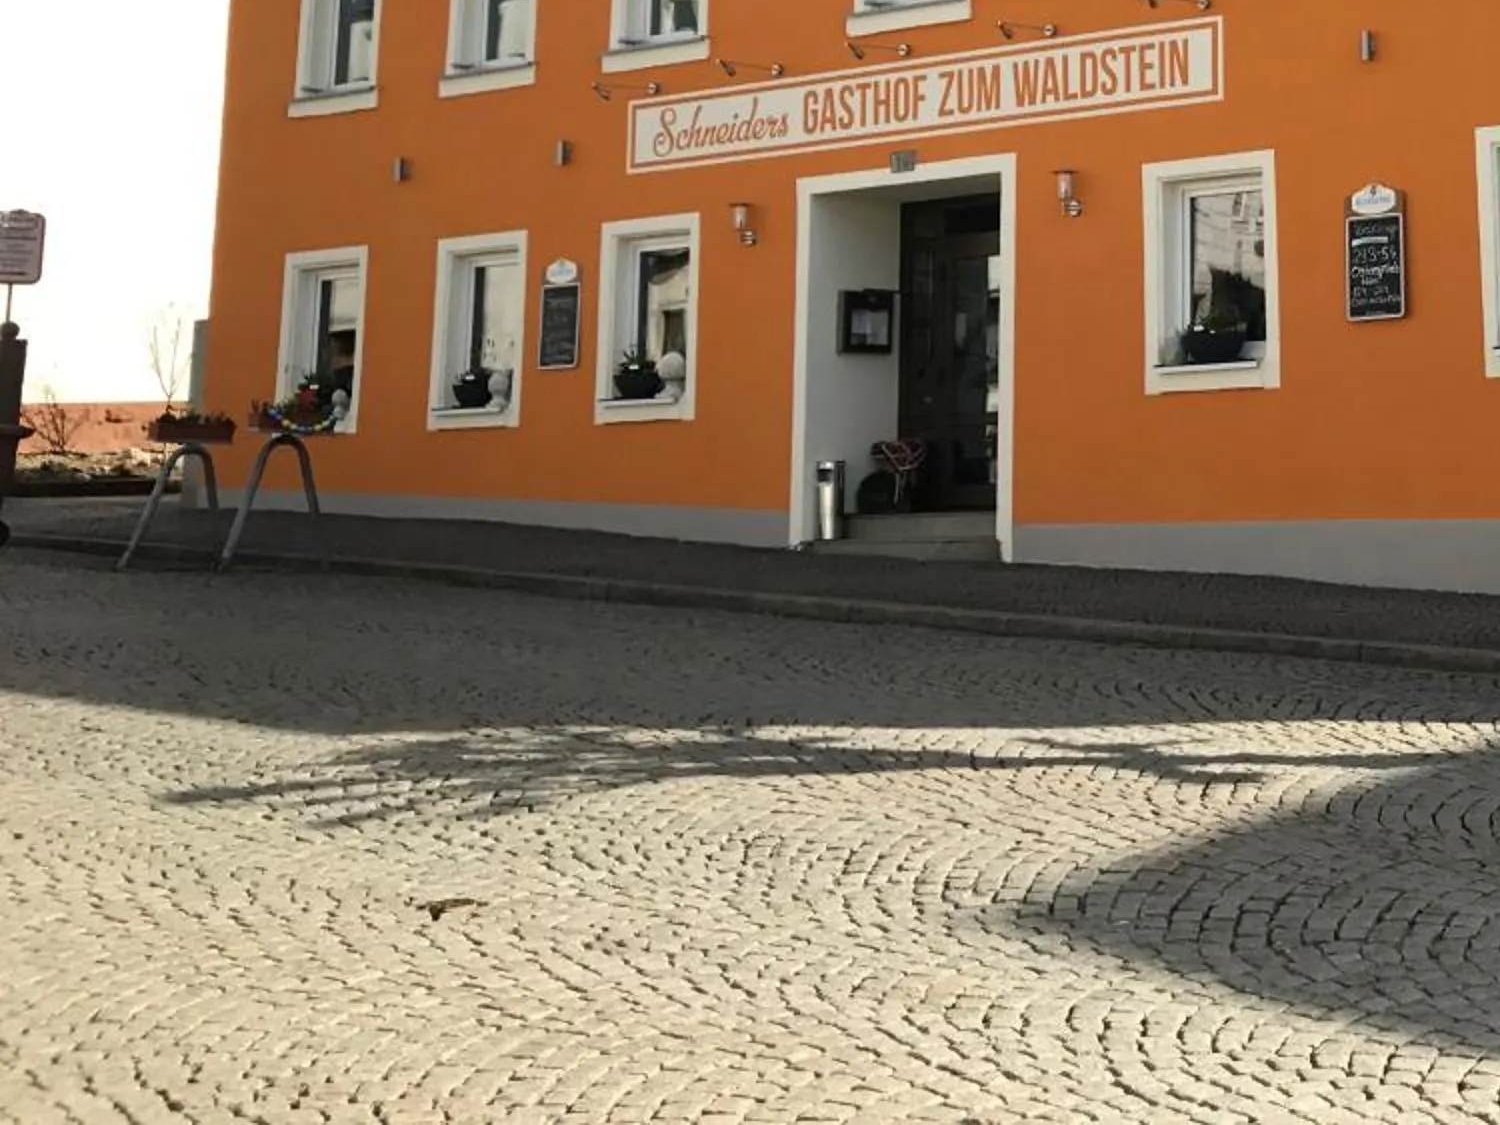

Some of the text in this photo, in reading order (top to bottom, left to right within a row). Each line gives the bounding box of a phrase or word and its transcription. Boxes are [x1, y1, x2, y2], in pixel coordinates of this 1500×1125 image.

[653, 39, 1189, 157] Schneiders GASTHOF ZUM WALDSTEIN
